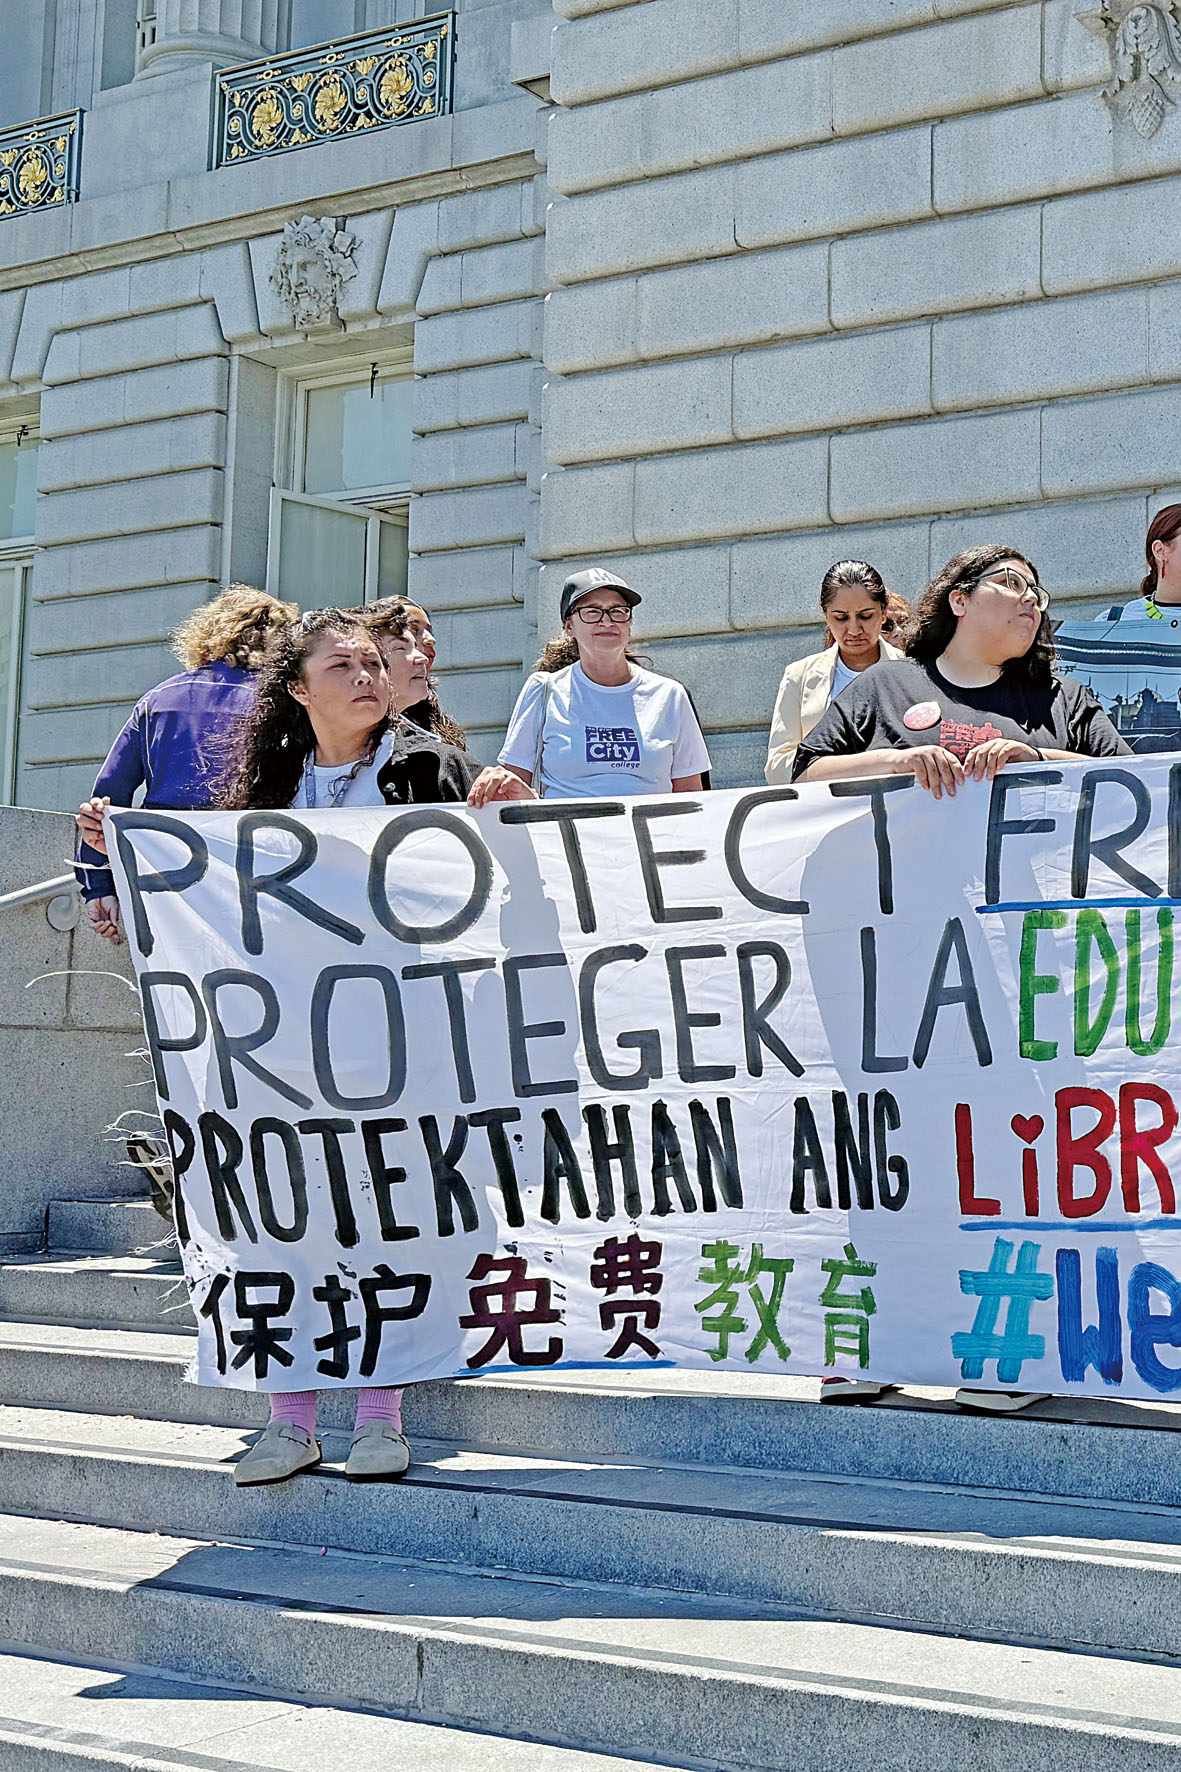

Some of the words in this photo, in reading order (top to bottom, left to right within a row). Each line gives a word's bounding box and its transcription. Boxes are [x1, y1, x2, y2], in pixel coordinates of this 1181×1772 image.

[585, 726, 637, 741] FREE
[590, 743, 635, 761] City
[611, 761, 640, 769] college
[110, 775, 915, 956] PROTECT
[139, 941, 805, 1111] PROTEGER
[862, 917, 993, 1073] LA
[162, 1097, 744, 1248] PROTEKTAHAN
[790, 1089, 908, 1214] ANG
